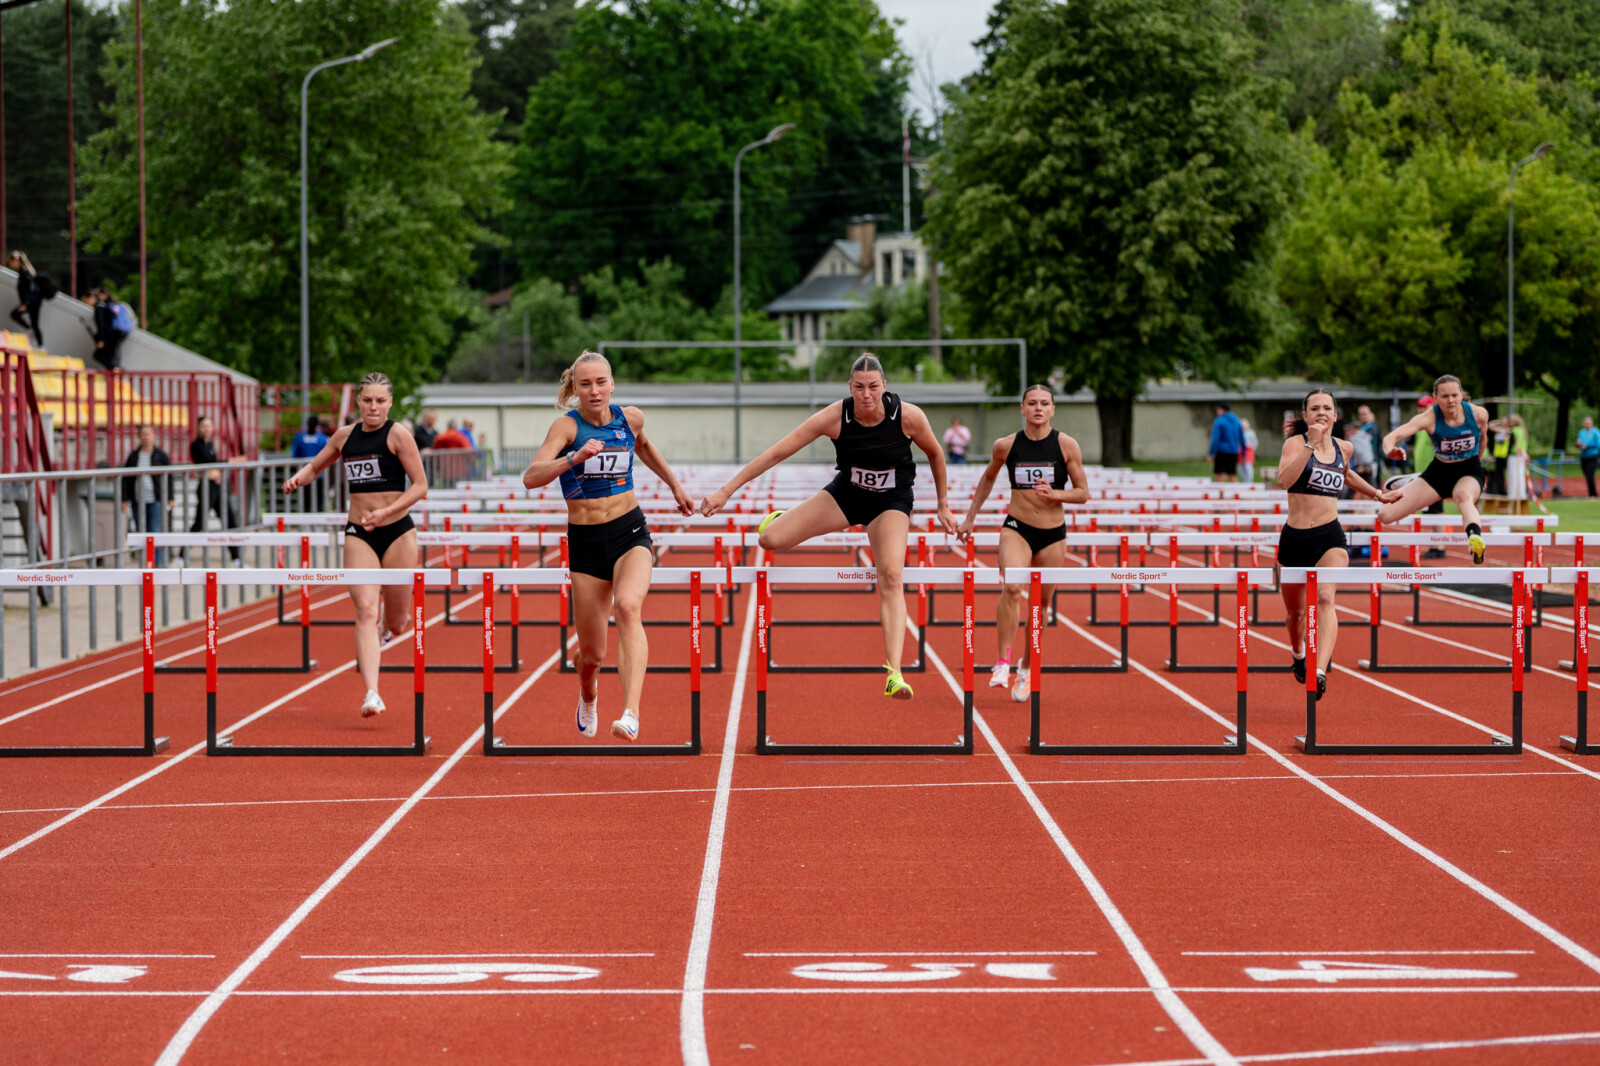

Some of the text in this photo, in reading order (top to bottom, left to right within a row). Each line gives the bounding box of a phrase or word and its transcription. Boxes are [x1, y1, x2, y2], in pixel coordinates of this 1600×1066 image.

[1445, 439, 1471, 452] 353
[348, 462, 374, 478] 179
[597, 455, 618, 472] 17
[856, 470, 890, 487] 187
[1025, 469, 1043, 482] 19
[1312, 470, 1342, 489] 200
[17, 574, 68, 583] Nordic Sport
[288, 573, 338, 582] Nordic Sport
[837, 572, 864, 580] Nordic
[1111, 572, 1161, 581] Nordic Sport
[1386, 572, 1436, 581] Nordic Sport
[144, 606, 152, 629] Nordic
[207, 606, 215, 629] Nordic
[415, 606, 423, 629] Nordic
[484, 606, 492, 629] Nordic
[692, 605, 700, 628] Nordic
[758, 605, 766, 628] Nordic
[965, 605, 973, 628] Nordic
[1032, 605, 1040, 628] Nordic
[1239, 605, 1247, 628] Nordic
[1308, 605, 1316, 628] Nordic
[1516, 605, 1524, 628] Nordic
[1578, 606, 1587, 628] Nordic
[332, 962, 601, 985] 6
[791, 961, 1057, 983] 5
[1244, 960, 1518, 983] 4
